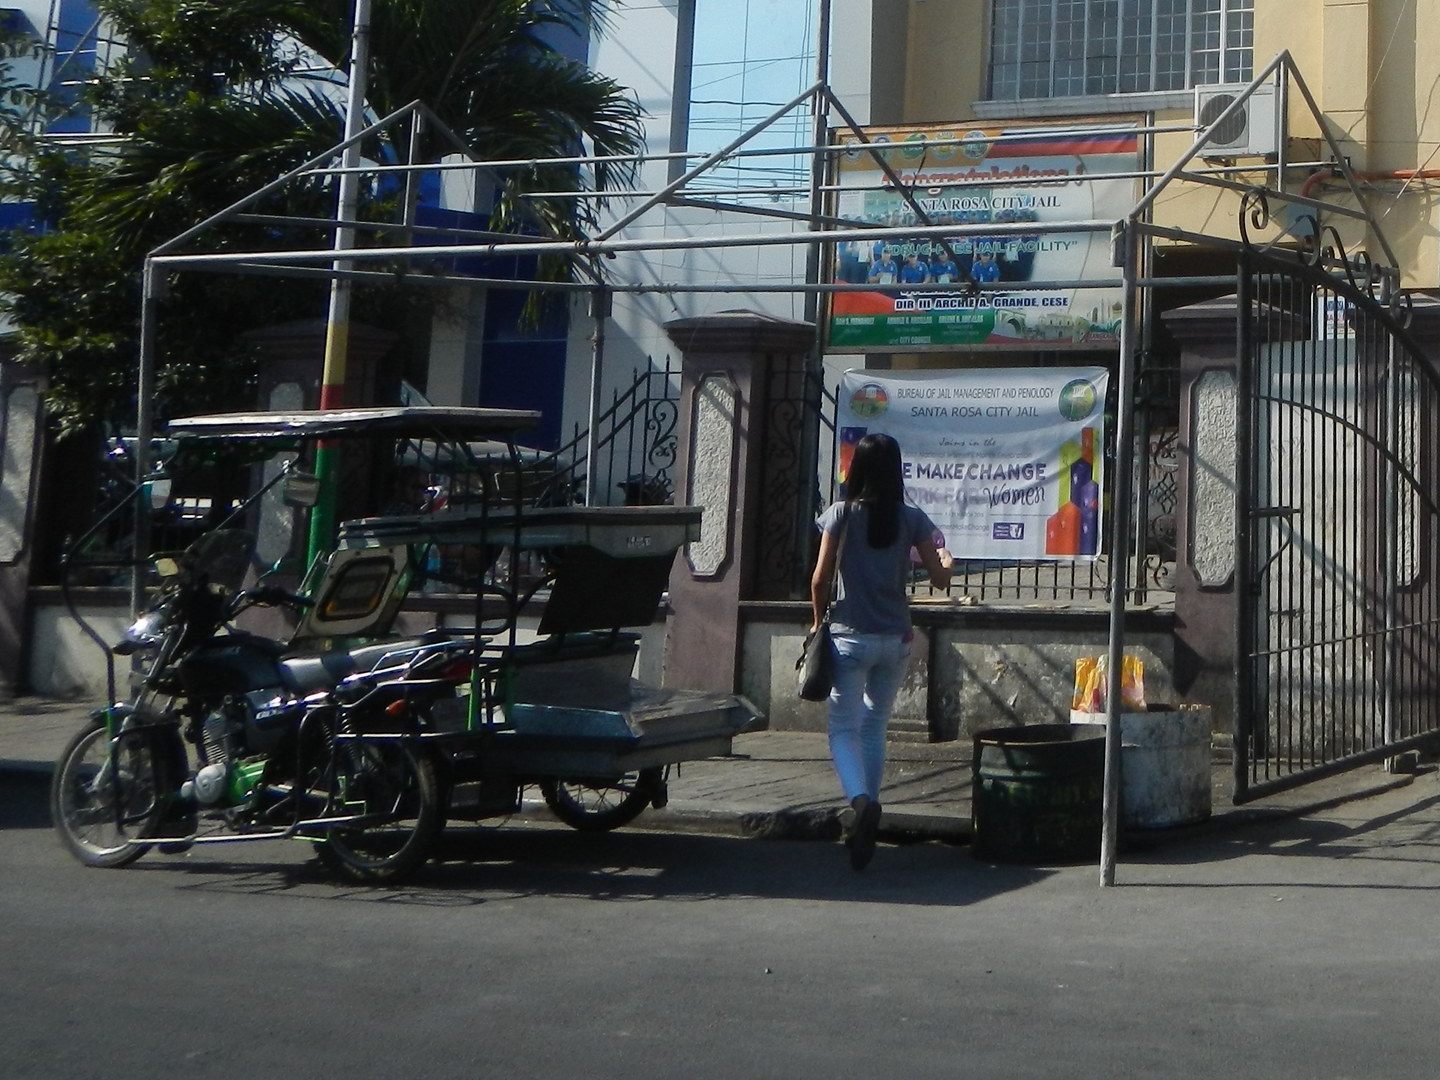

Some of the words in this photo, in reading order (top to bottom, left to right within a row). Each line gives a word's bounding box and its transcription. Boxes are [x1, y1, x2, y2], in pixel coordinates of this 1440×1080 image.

[950, 196, 990, 211] ROSA
[991, 196, 1029, 210] CITY
[1030, 195, 1061, 209] JAIL
[974, 241, 1006, 254] JAIL
[895, 299, 914, 311] DIR
[1041, 296, 1069, 307] CESE
[897, 388, 925, 399] BUREAU
[925, 388, 936, 399] OF
[936, 388, 951, 399] JAIL
[952, 387, 1000, 399] MANAGEMENT
[1001, 387, 1017, 398] AND
[1017, 387, 1055, 398] PENOLOGY
[911, 406, 948, 418] SANTA
[951, 406, 983, 418] ROSA
[985, 406, 1013, 418] CITY
[1015, 406, 1039, 417] JAIL
[969, 438, 980, 447] in
[983, 437, 996, 447] the
[902, 463, 912, 479] E
[916, 463, 964, 480] MAKE
[967, 463, 1047, 480] CHANGE
[983, 483, 1045, 509] Women
